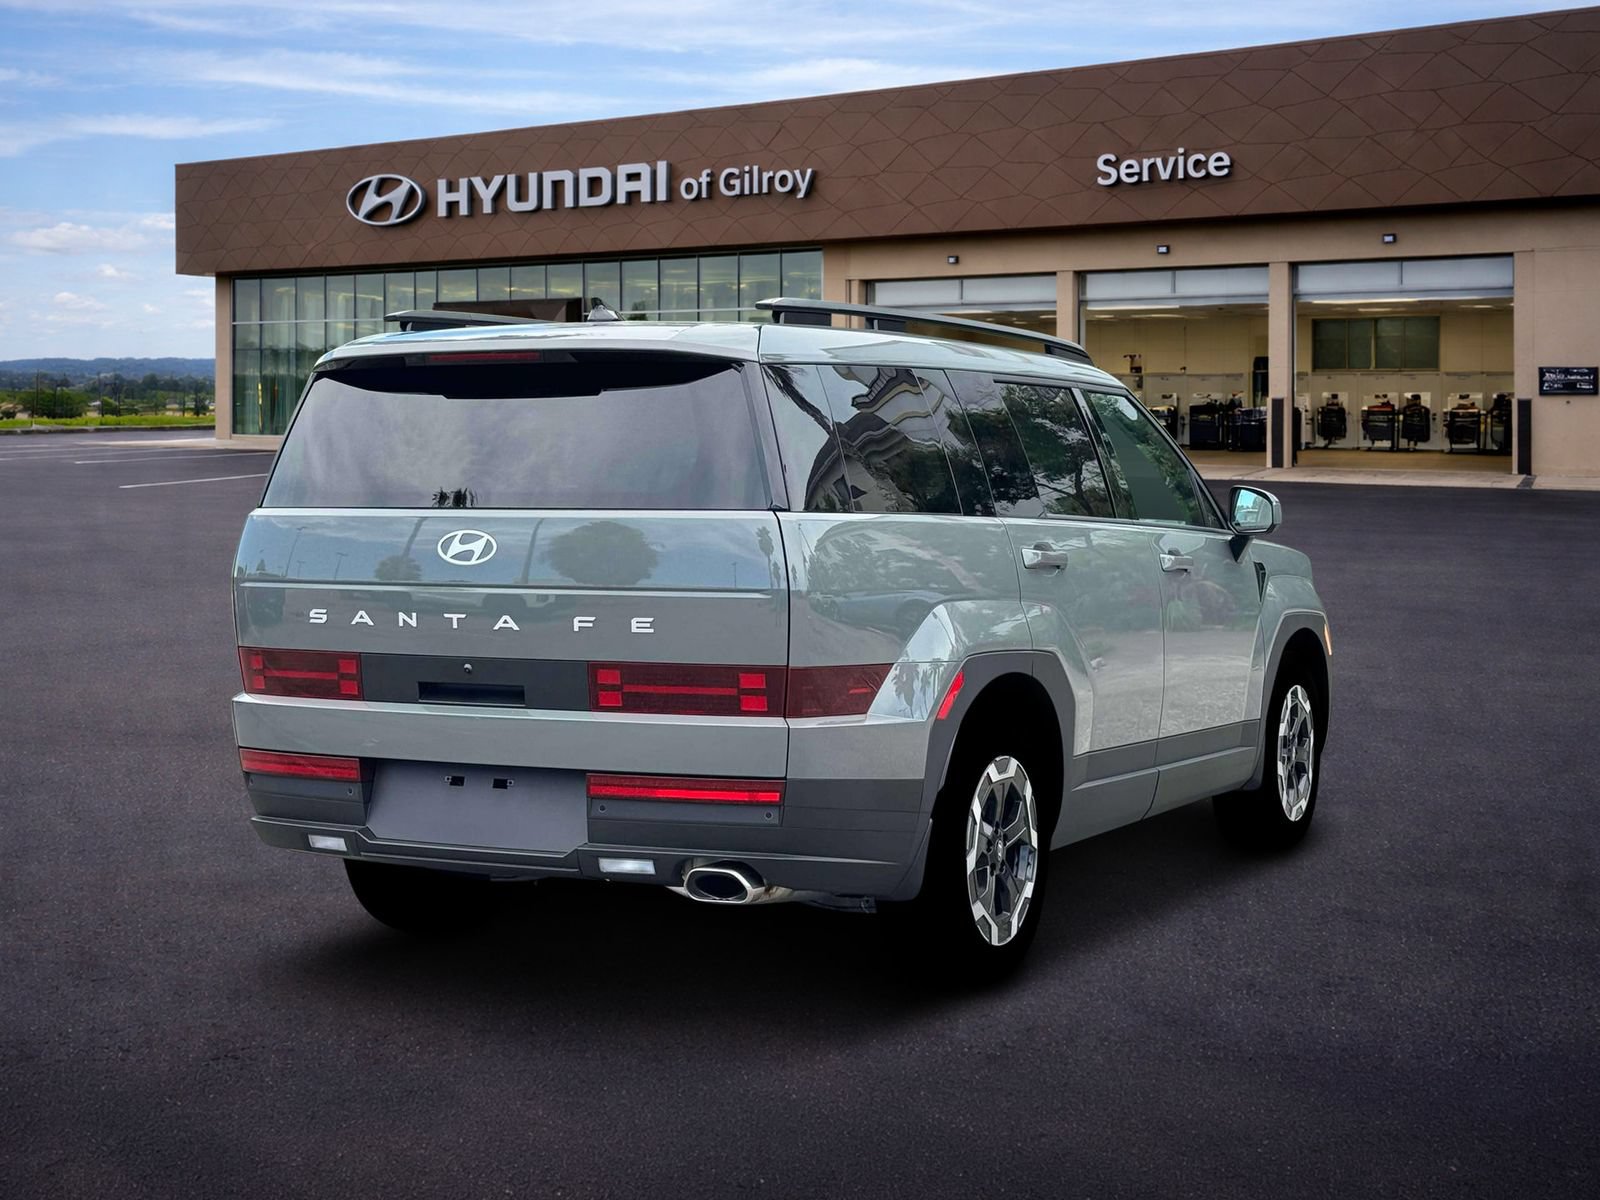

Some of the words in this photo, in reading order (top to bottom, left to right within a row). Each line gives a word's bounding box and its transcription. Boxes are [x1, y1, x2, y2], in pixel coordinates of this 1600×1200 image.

[1096, 147, 1232, 187] Service
[436, 160, 669, 217] HYUNDAI
[680, 169, 711, 200] of
[719, 164, 814, 199] Gilroy
[308, 608, 520, 631] SANTA
[573, 616, 655, 633] FE
